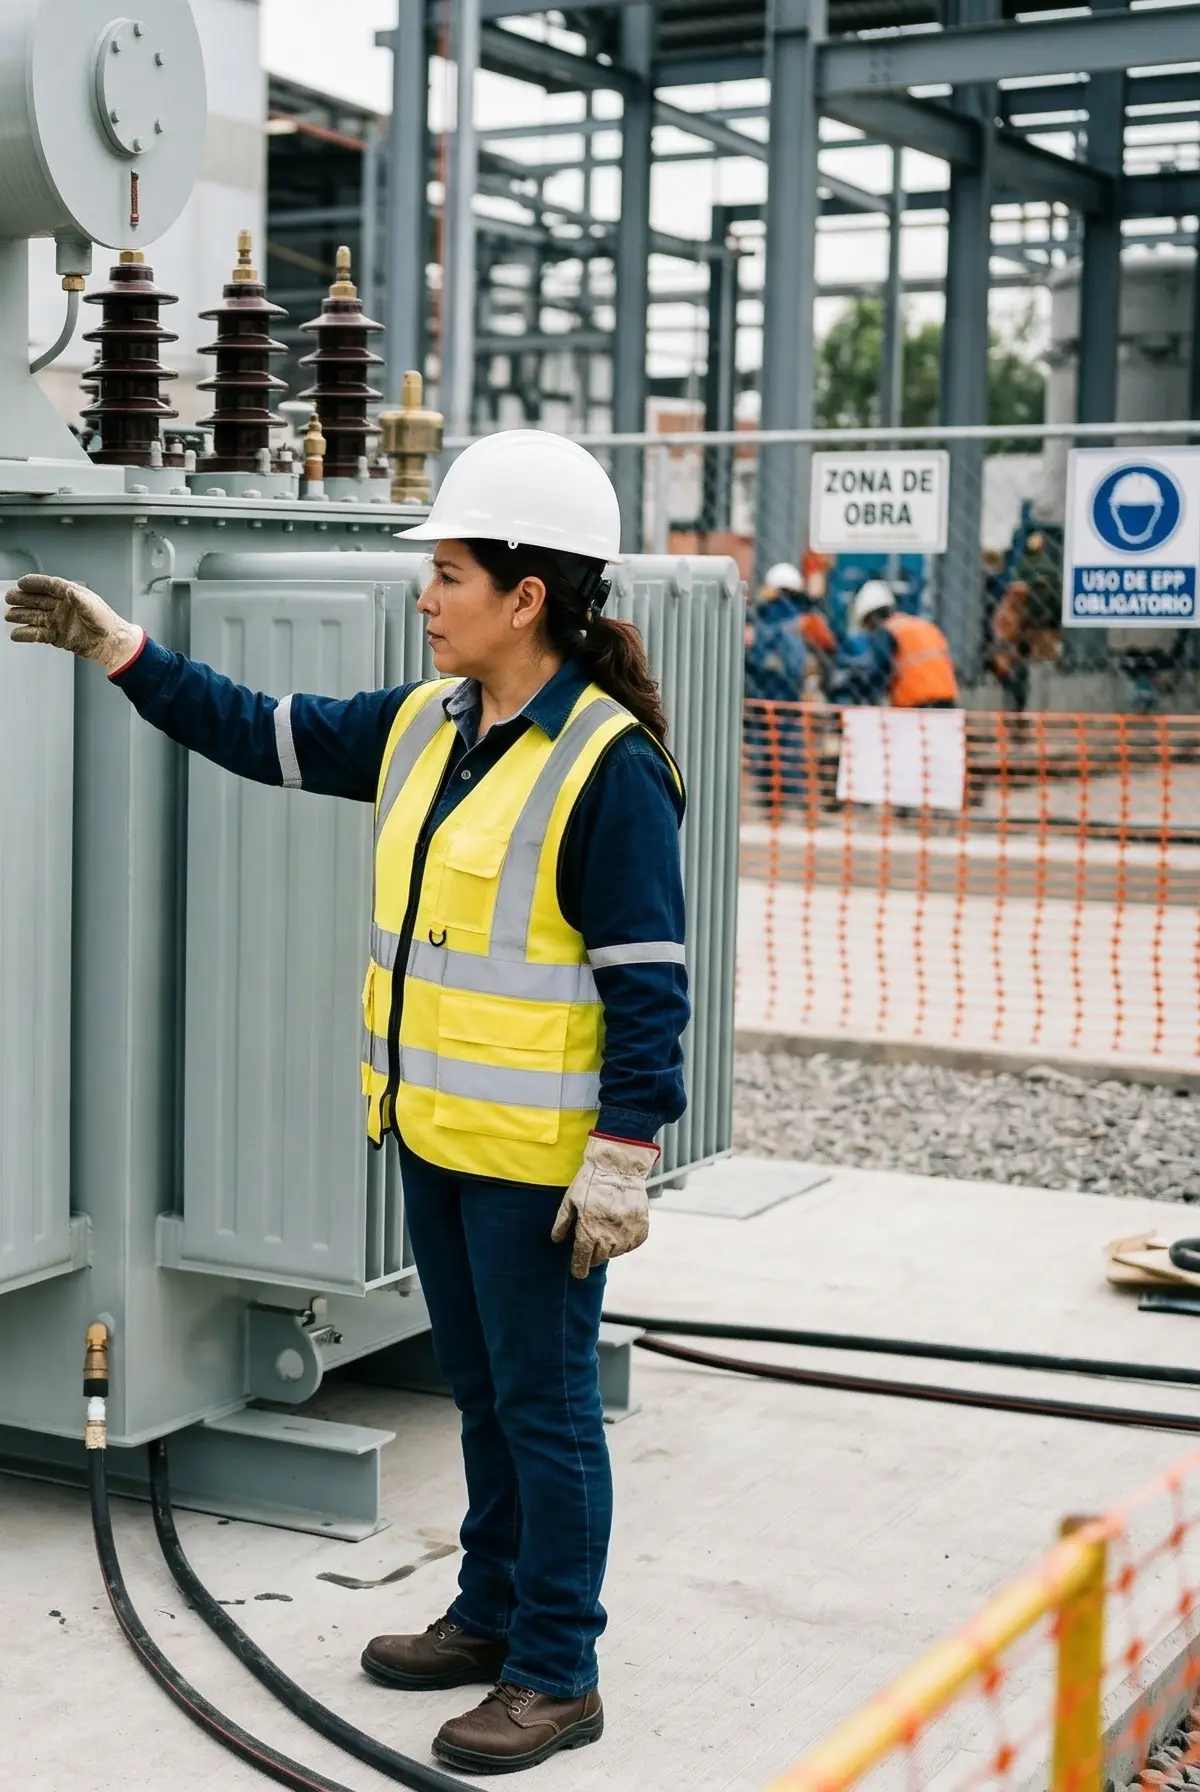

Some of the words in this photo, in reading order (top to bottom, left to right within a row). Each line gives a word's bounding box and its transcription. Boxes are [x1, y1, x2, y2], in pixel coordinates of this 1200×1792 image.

[825, 469, 892, 493] ZONA
[902, 469, 933, 493] DE
[844, 501, 912, 526] OBRA
[1082, 569, 1120, 592] USO
[1123, 569, 1147, 592] DE
[1151, 569, 1186, 592] EPP
[1074, 592, 1193, 615] OBLIGATORIO
